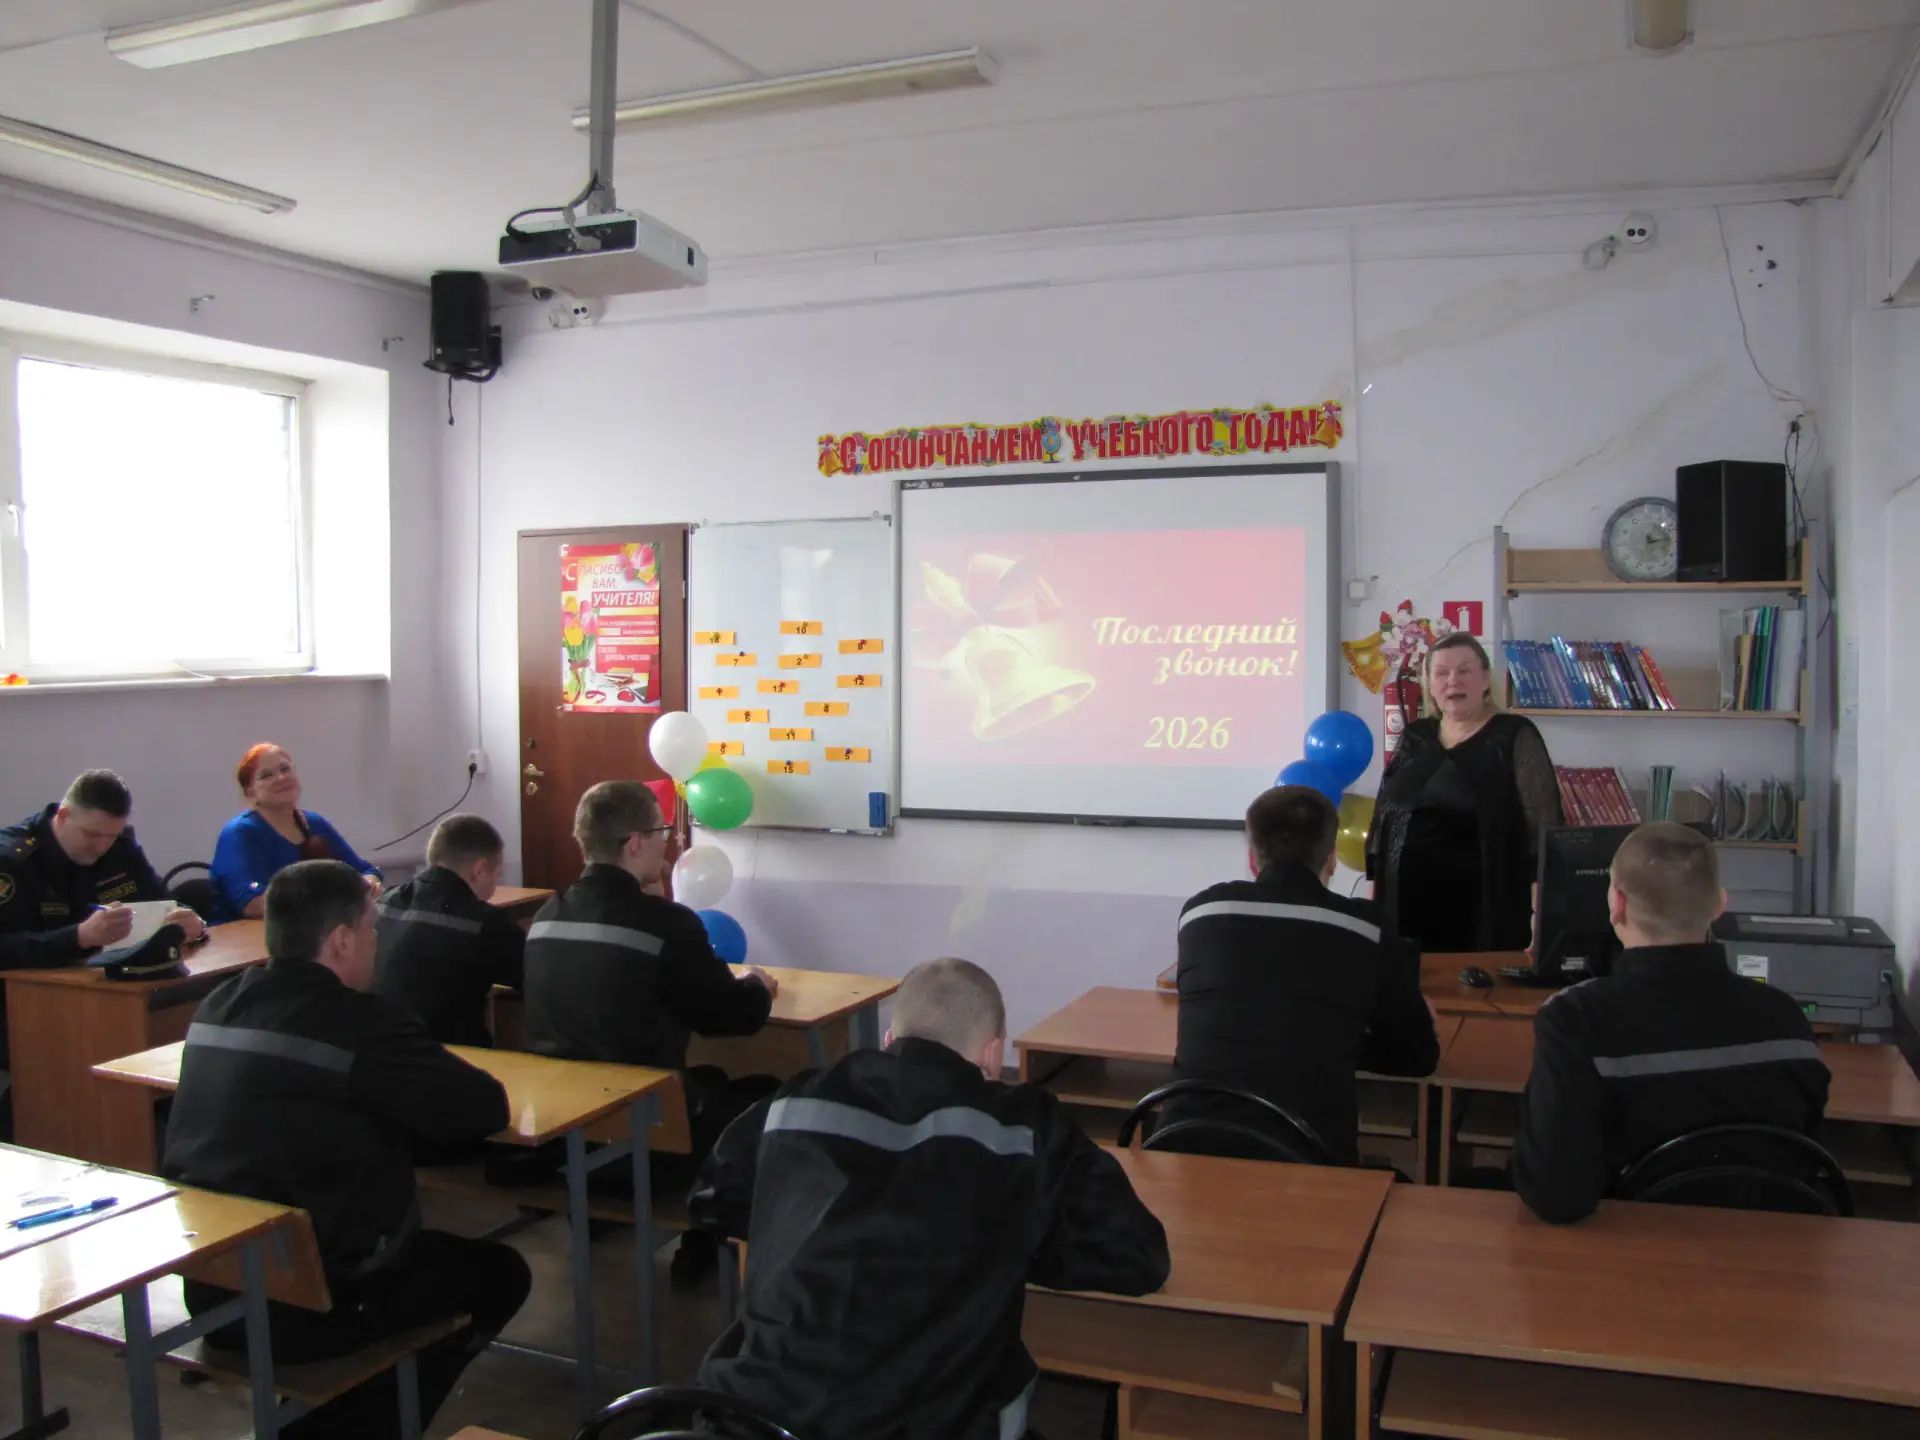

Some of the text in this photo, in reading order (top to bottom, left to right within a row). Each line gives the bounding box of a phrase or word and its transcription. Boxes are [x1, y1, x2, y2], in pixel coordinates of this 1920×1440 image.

[840, 408, 1320, 473] С ОКОНЧАНИЕМ УЧЕБНОГО ГОДА!
[565, 562, 622, 580] СПАСИБО
[593, 590, 655, 606] УЧИТЕЛЯ!
[795, 626, 807, 635] 10
[1092, 616, 1298, 652] Последний
[857, 642, 864, 651] 8
[733, 658, 740, 667] 7
[796, 657, 803, 666] 2
[1152, 648, 1299, 685] звонок!
[854, 677, 865, 686] 12
[1143, 716, 1233, 749] 2026
[783, 765, 794, 774] 15
